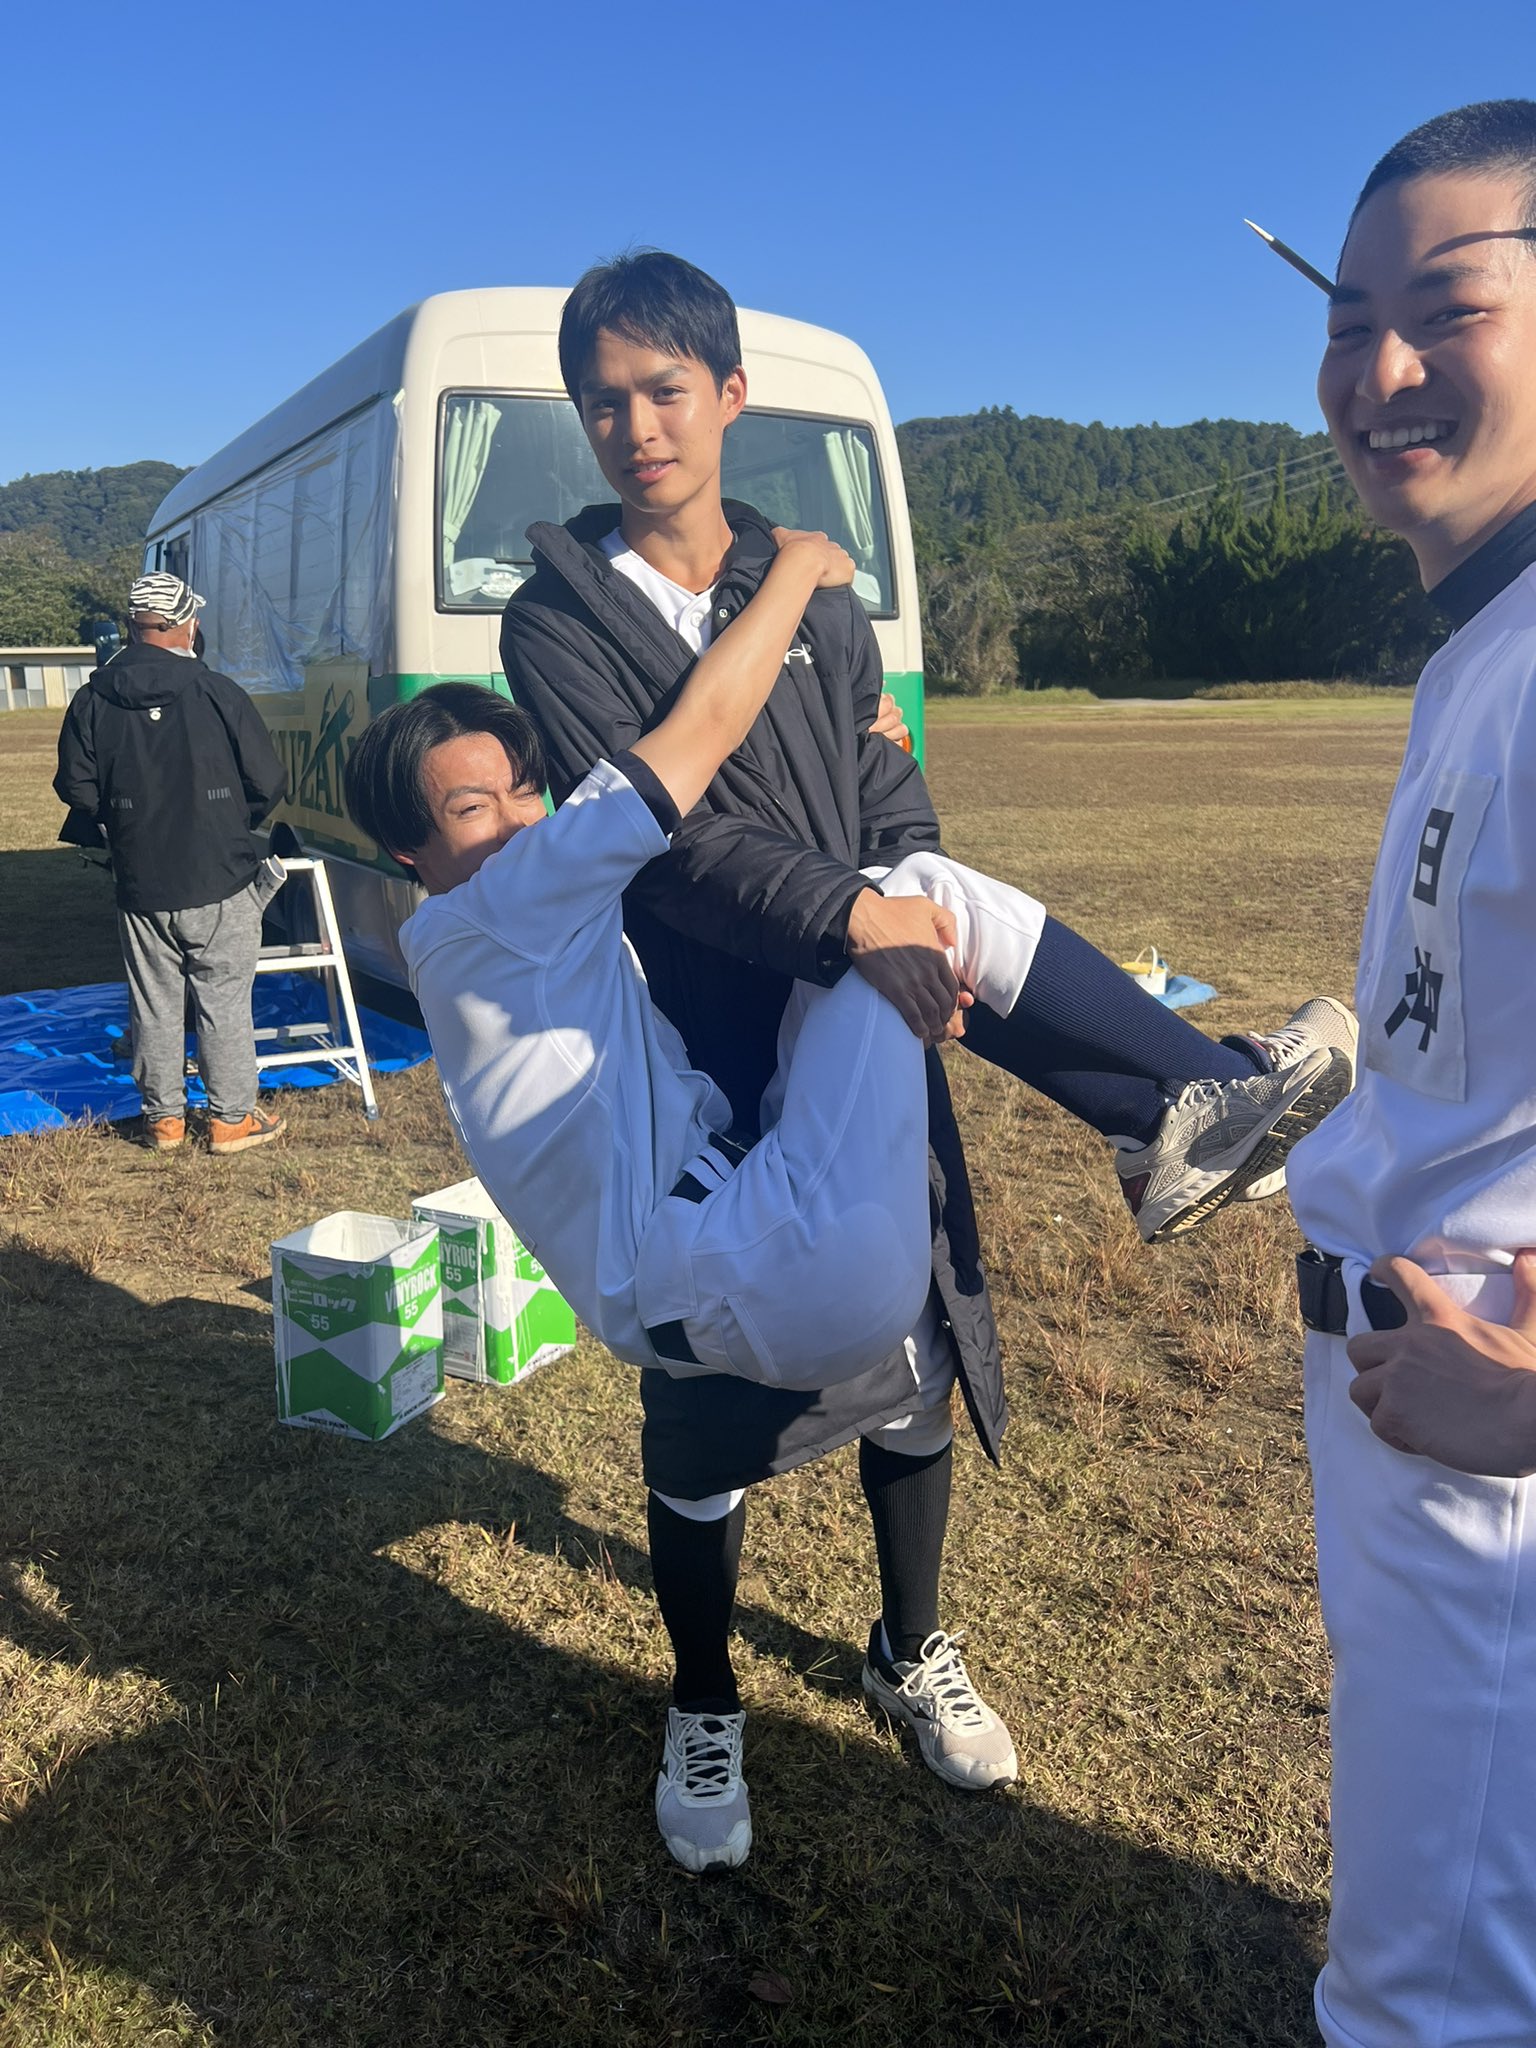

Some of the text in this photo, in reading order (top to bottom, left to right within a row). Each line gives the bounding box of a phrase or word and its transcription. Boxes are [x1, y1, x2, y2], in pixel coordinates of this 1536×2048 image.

[270, 729, 357, 819] UZAN
[445, 1266, 462, 1283] 55
[286, 1286, 357, 1313] ビニロック
[385, 1263, 437, 1313] VINYROCK
[310, 1312, 330, 1332] 55
[404, 1299, 419, 1321] 55
